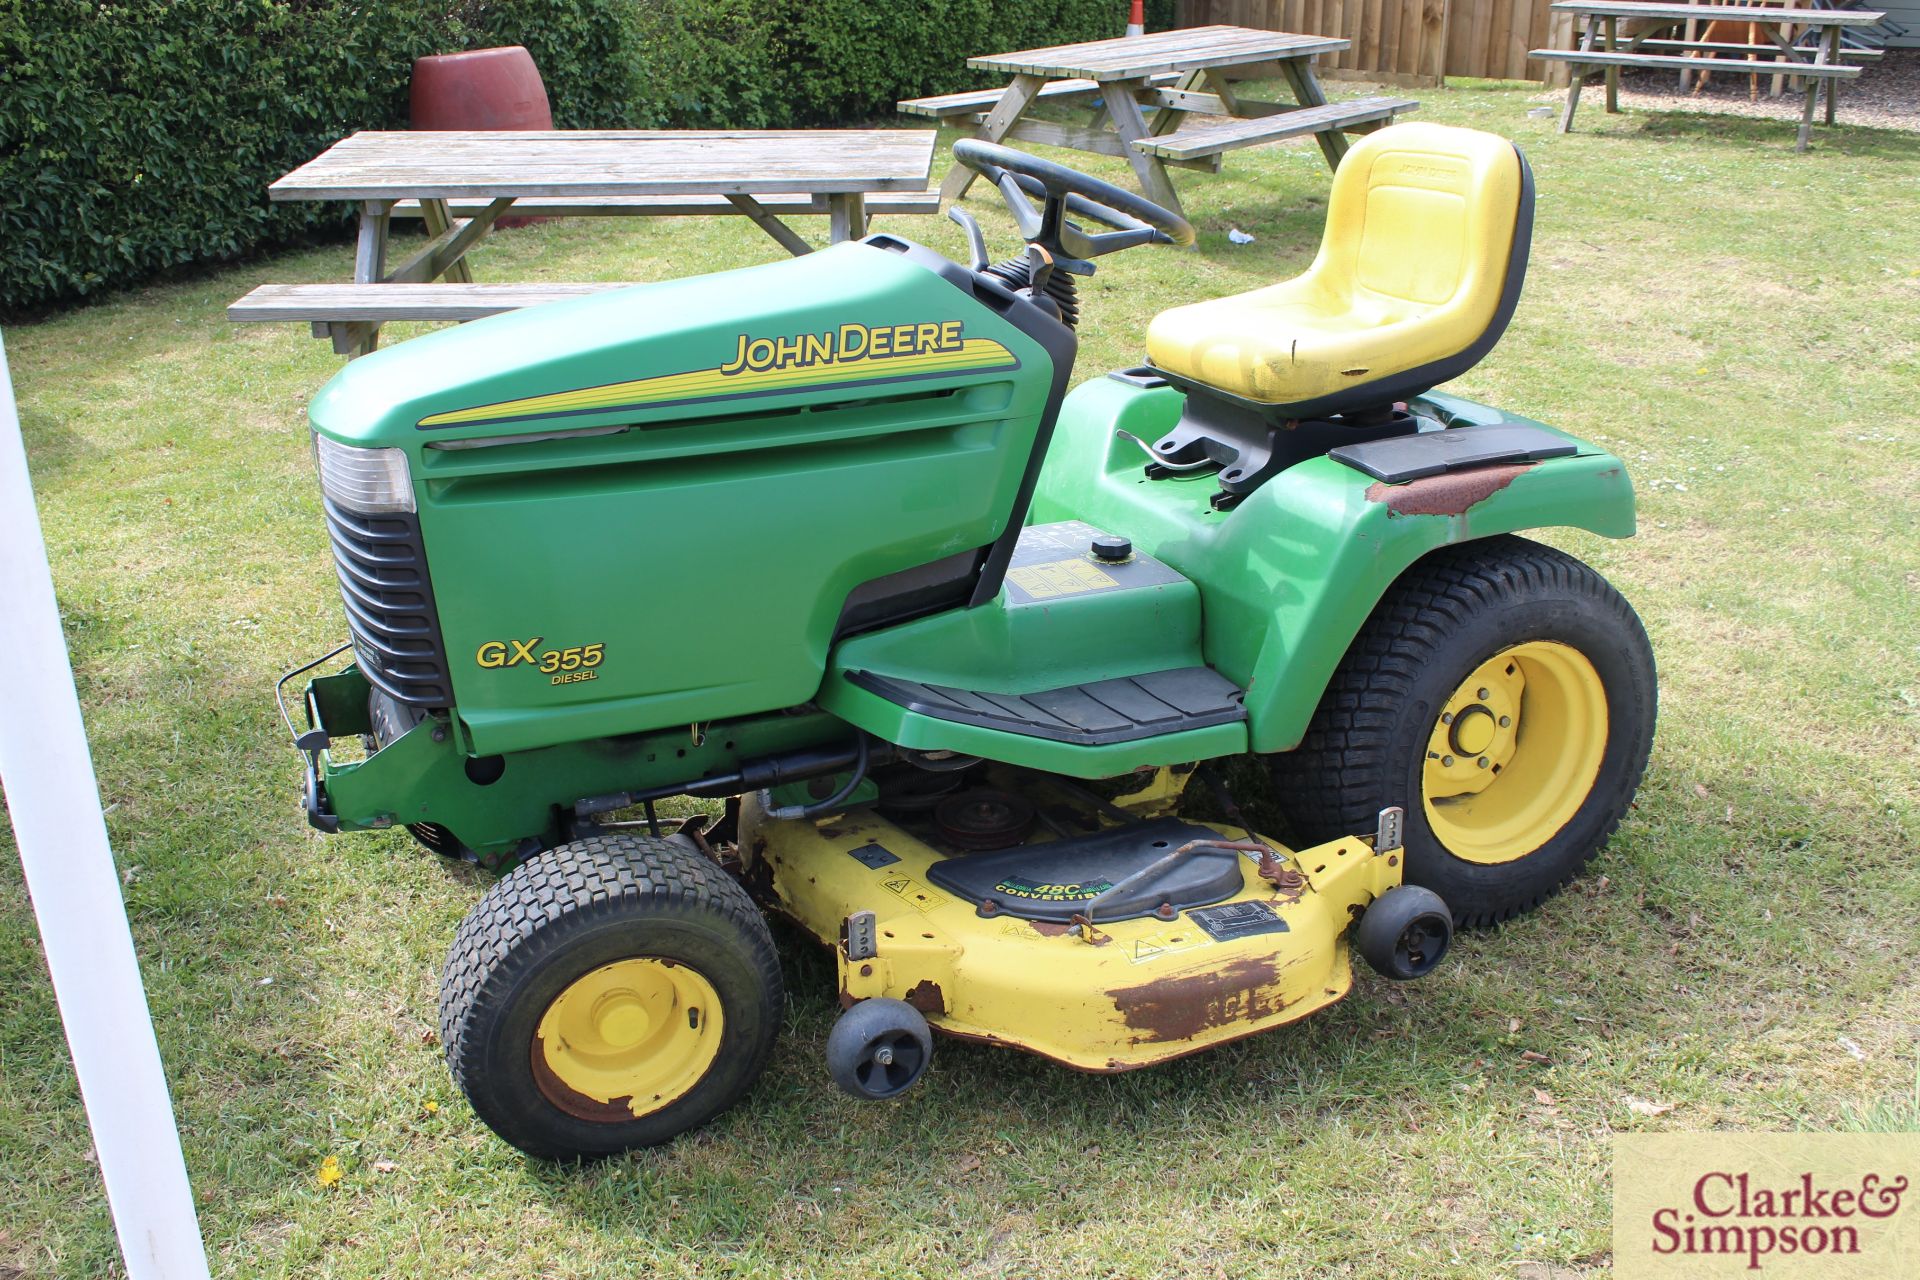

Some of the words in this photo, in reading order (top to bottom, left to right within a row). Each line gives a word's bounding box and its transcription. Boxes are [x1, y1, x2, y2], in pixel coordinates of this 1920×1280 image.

[720, 332, 834, 376] JOHN
[837, 321, 963, 362] DEERE
[551, 669, 599, 686] DIESEL
[1033, 883, 1081, 896] 48C
